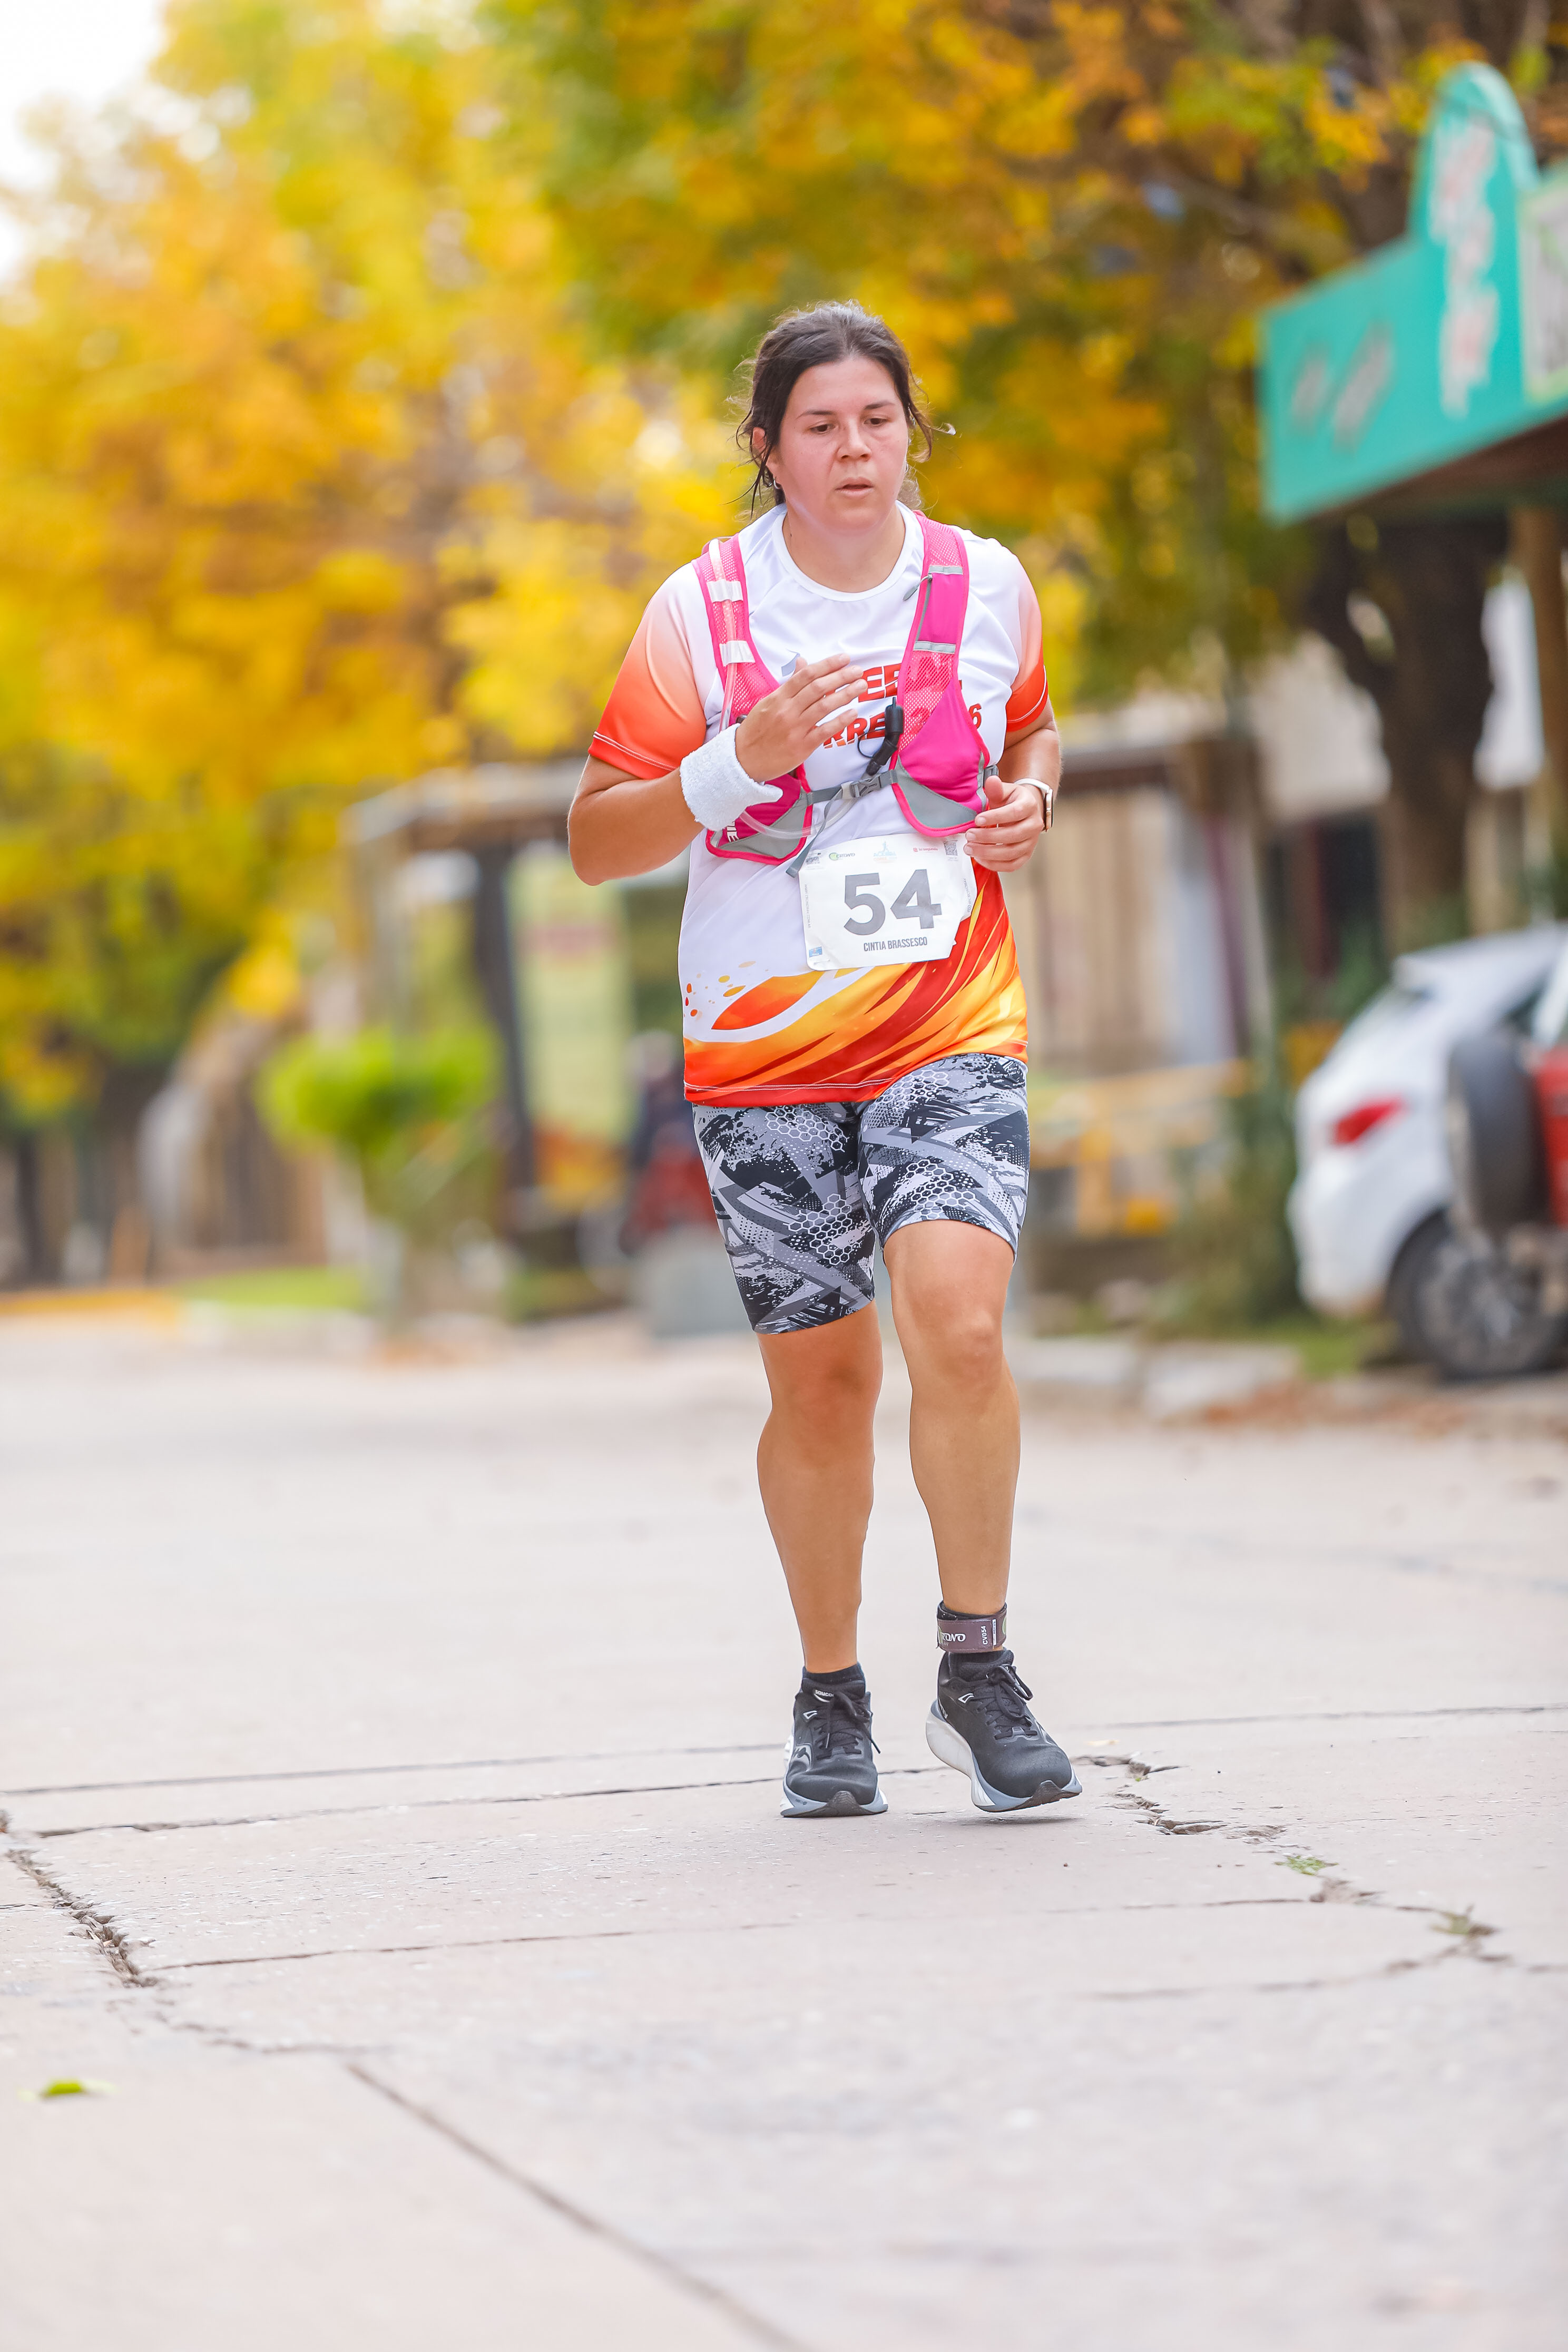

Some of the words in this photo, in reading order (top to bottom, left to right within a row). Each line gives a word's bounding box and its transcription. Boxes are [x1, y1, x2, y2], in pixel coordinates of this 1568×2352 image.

[844, 869, 942, 936] 54
[864, 941, 886, 952] CINTIA
[888, 937, 927, 949] BRASSESCO
